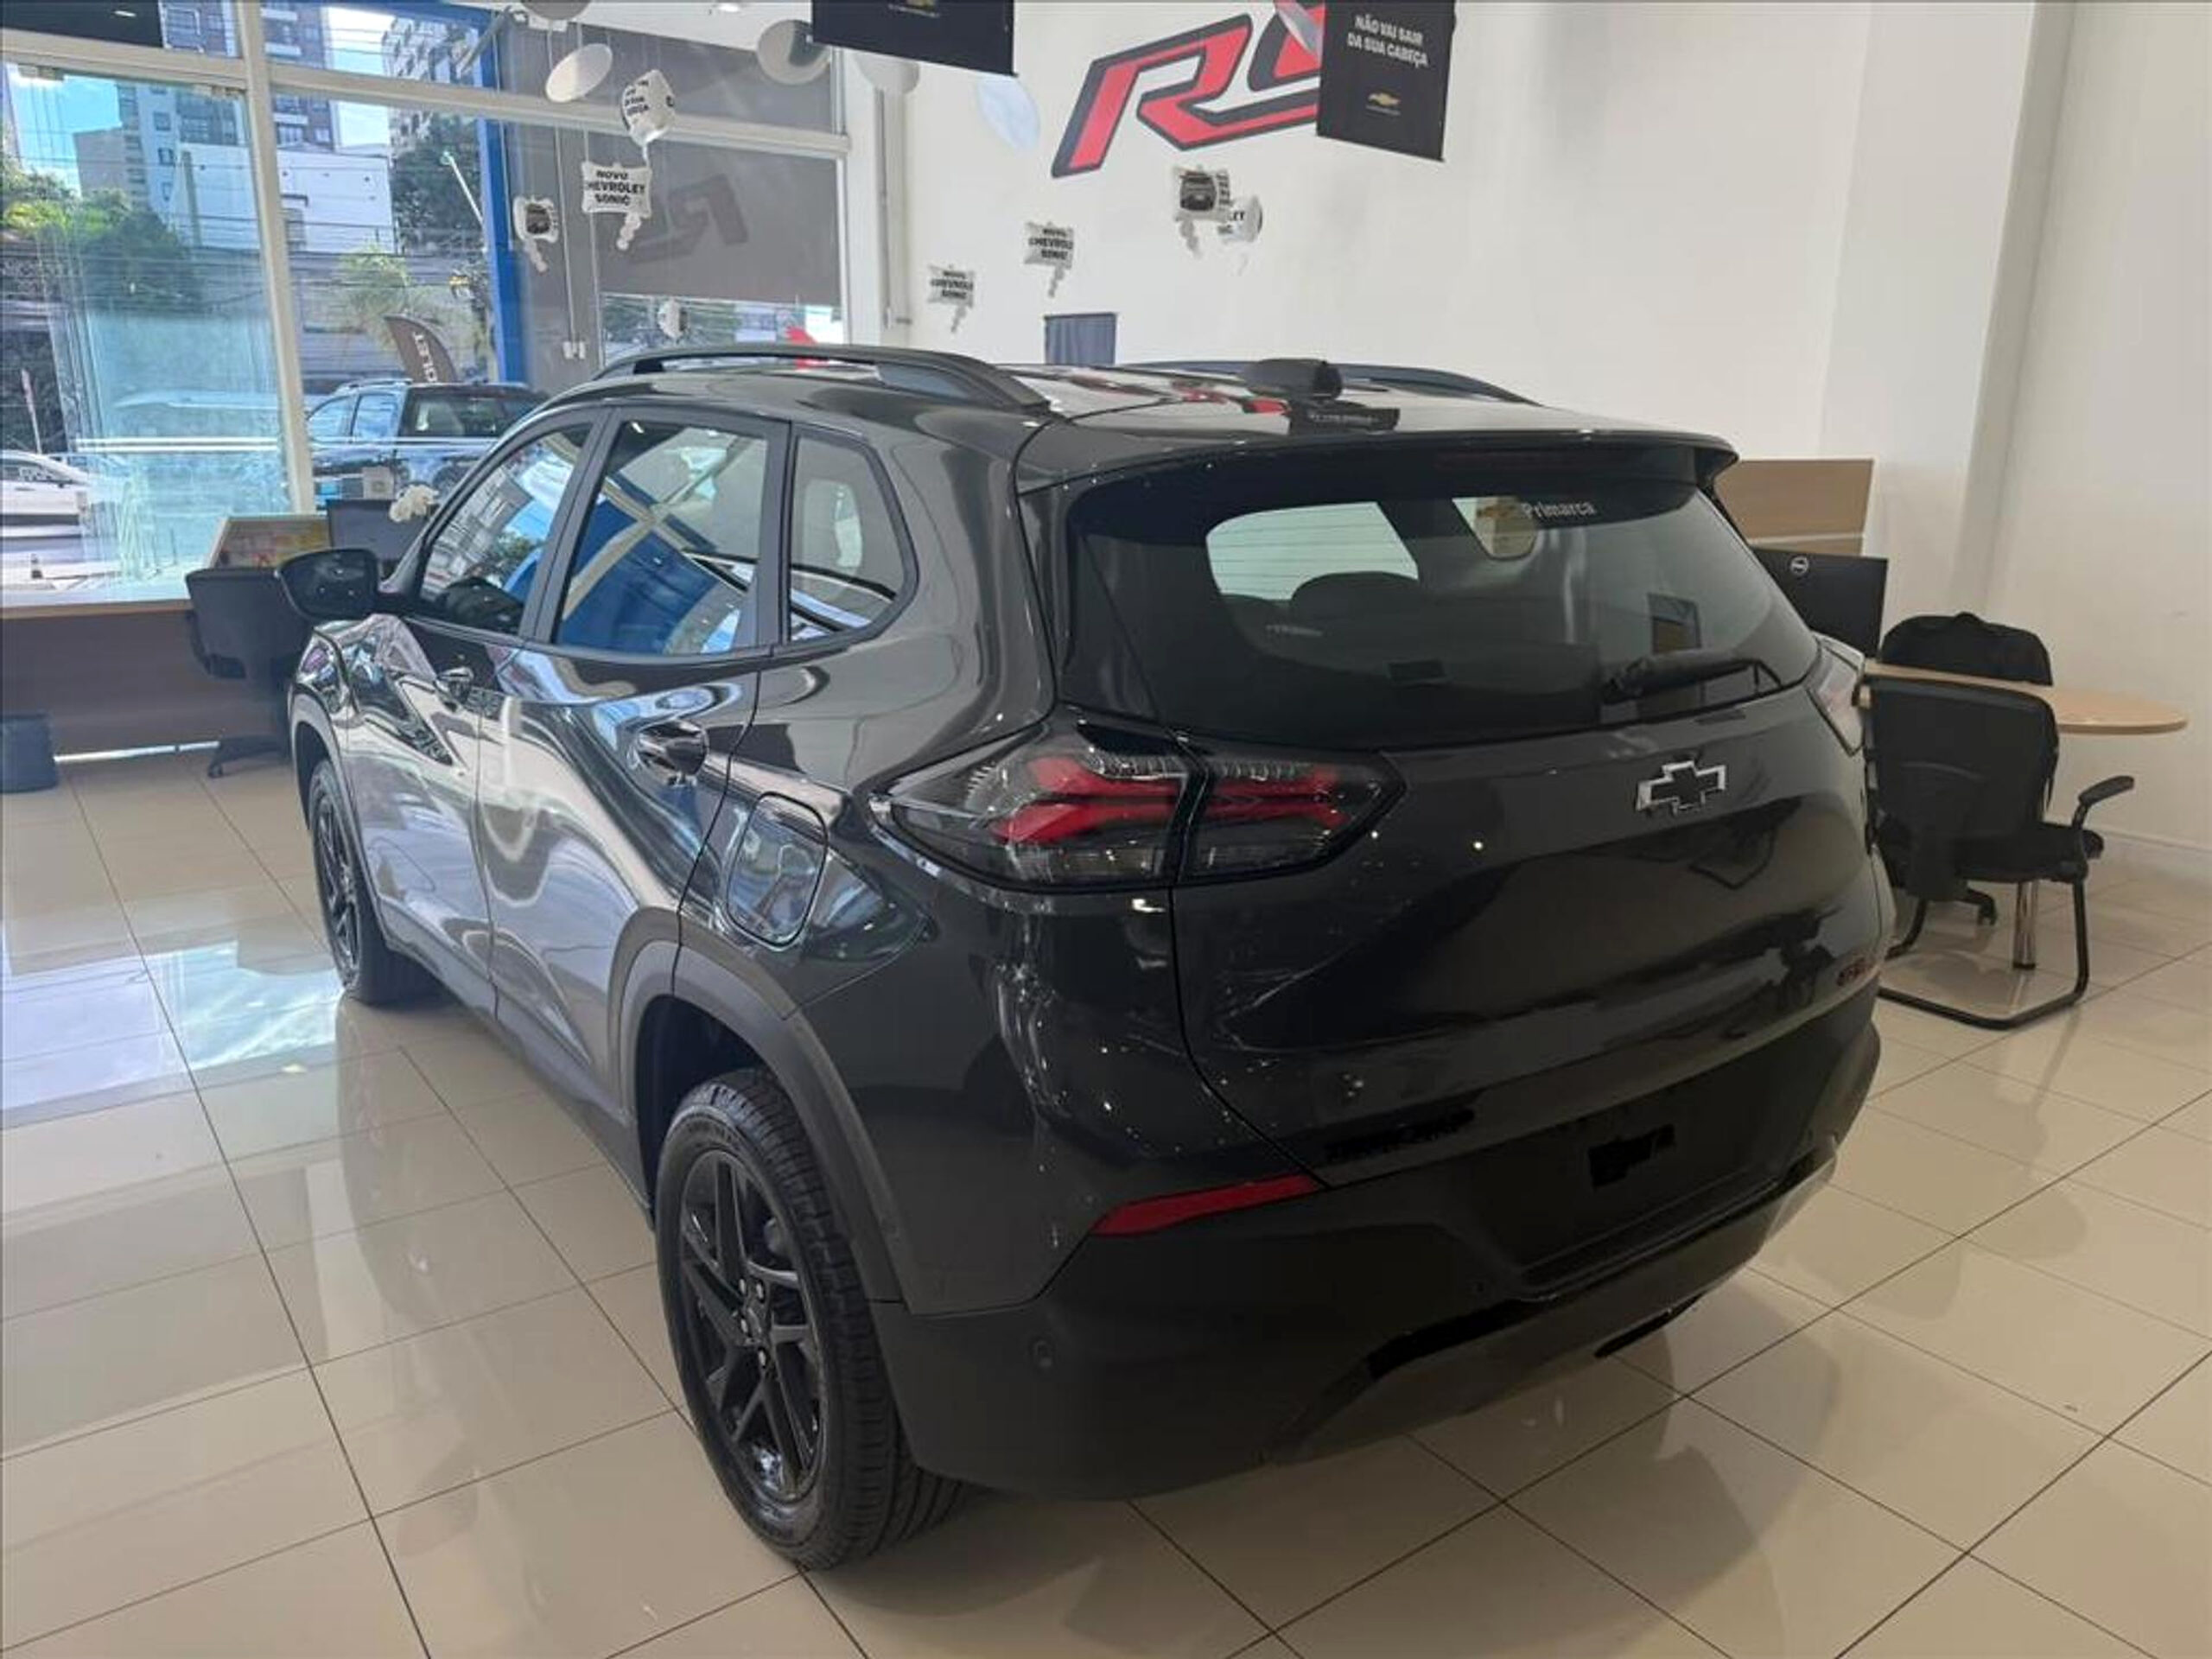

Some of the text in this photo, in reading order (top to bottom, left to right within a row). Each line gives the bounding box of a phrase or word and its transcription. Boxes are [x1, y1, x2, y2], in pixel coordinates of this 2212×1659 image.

[1355, 13, 1380, 35] NÃO
[1347, 32, 1363, 50] DA
[1386, 42, 1429, 68] CABEÇA
[1521, 501, 1597, 519] Primarca
